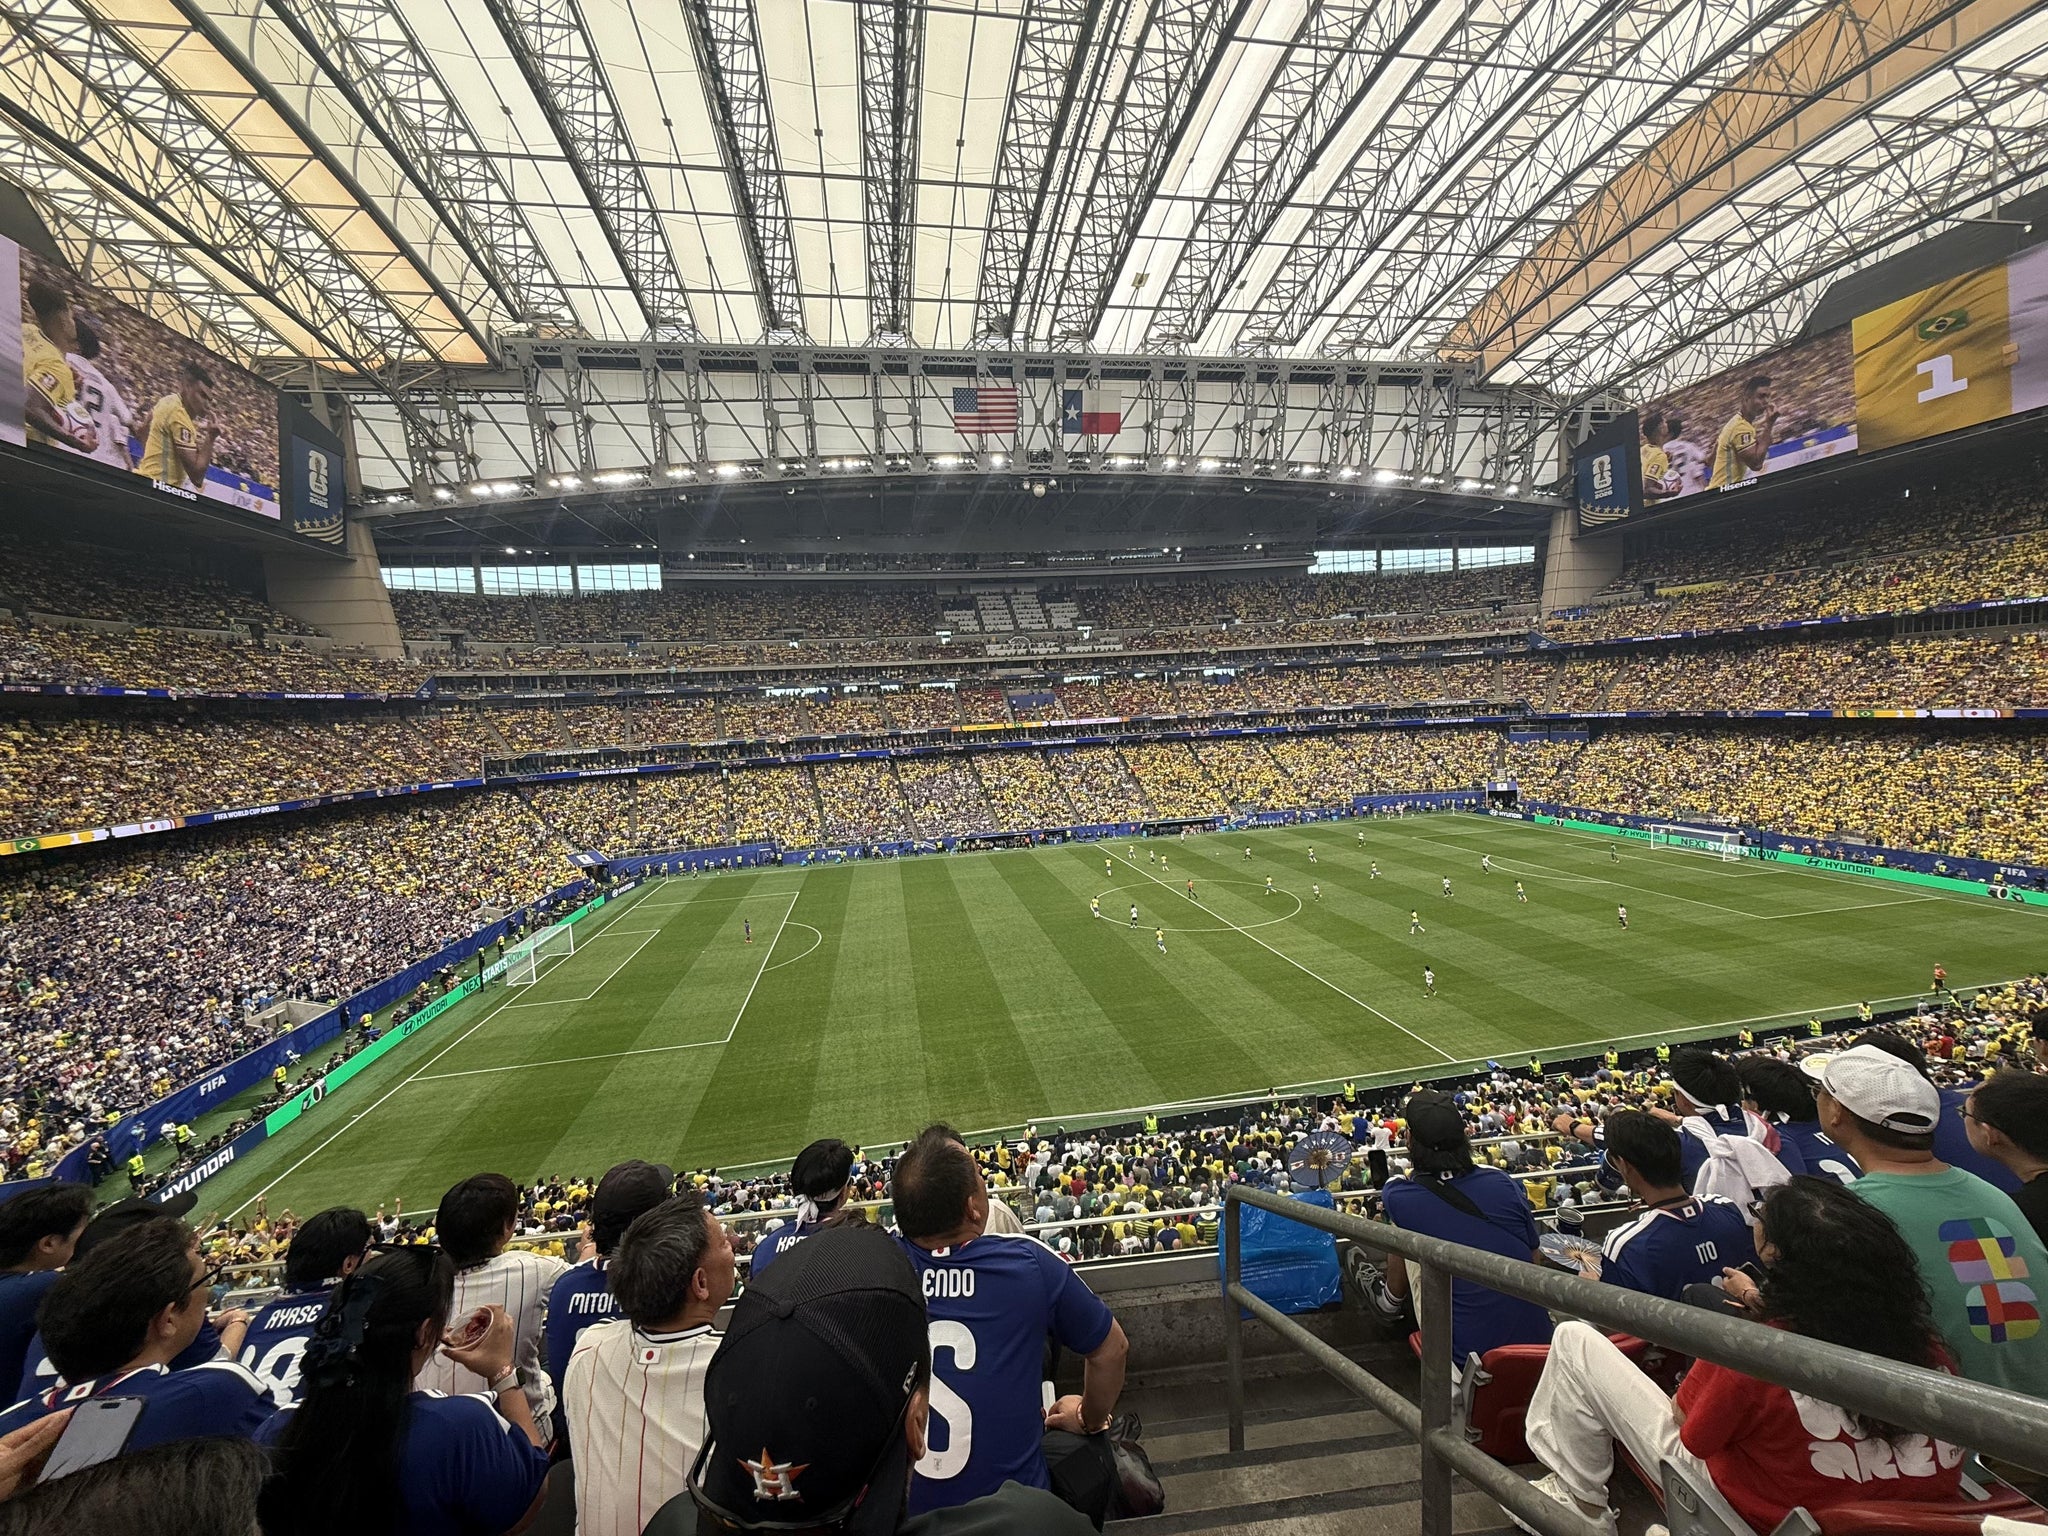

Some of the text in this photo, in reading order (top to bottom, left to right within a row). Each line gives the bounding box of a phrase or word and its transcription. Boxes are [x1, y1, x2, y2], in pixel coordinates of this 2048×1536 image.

[1916, 354, 1968, 404] 1
[152, 479, 197, 502] Hisense
[1719, 477, 1758, 493] Hisense
[214, 812, 228, 821] FIFA
[228, 809, 249, 818] WORLD
[261, 805, 280, 814] 2026
[1498, 811, 1522, 819] HYUNDAI
[1681, 838, 1779, 860] NEXT STARTS NOW
[1825, 862, 1875, 875] HYUNDAI
[2000, 866, 2028, 878] FIFA
[482, 958, 508, 984] STARTS
[416, 1000, 448, 1025] HYUNDAI
[200, 1074, 227, 1096] FIFA
[160, 1146, 234, 1203] HYUNDAI
[1695, 1240, 1718, 1265] ITO
[922, 1268, 975, 1298] ENDO
[264, 1304, 323, 1330] AYASE
